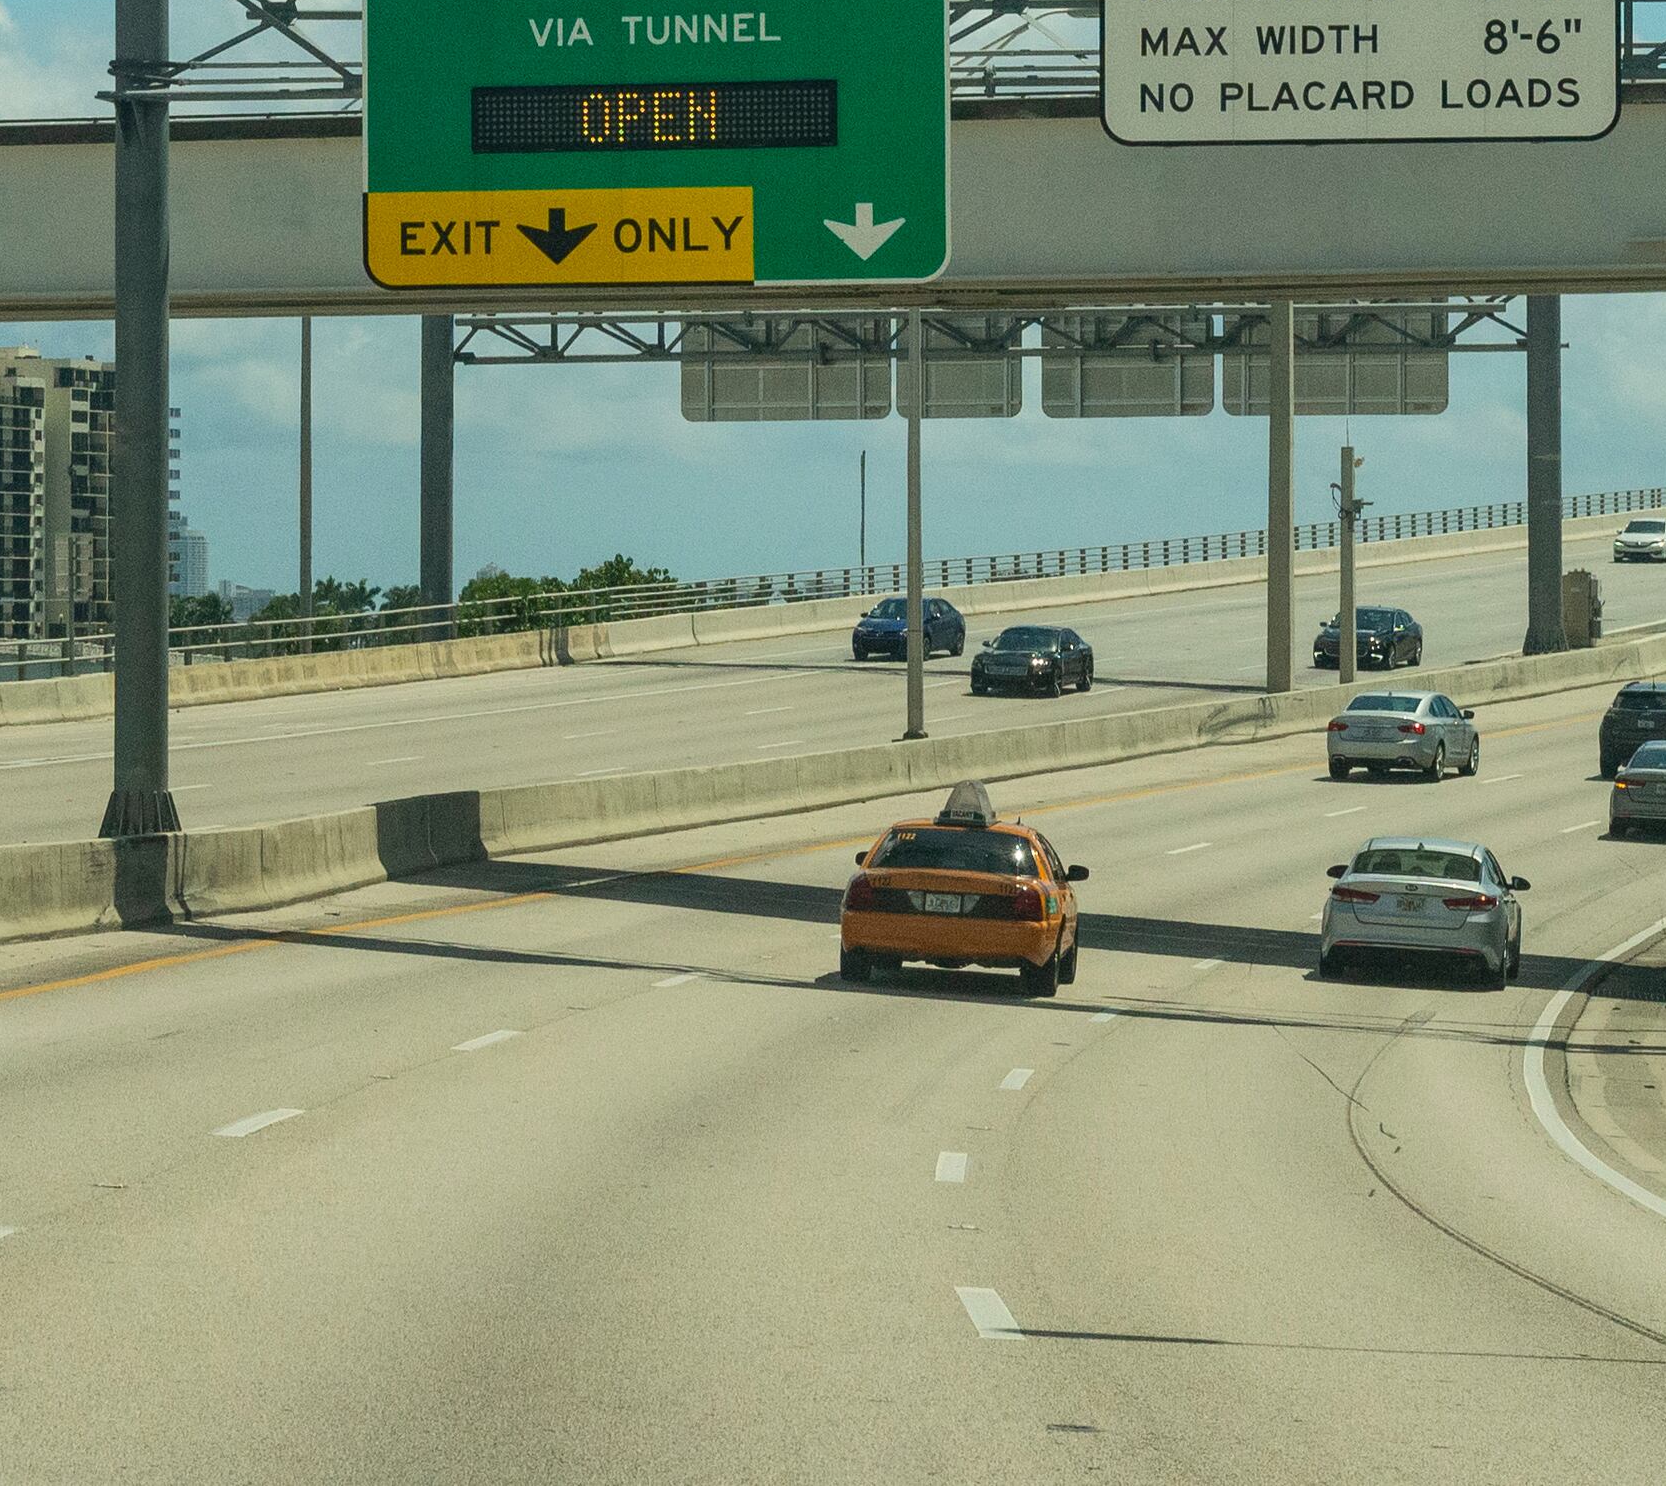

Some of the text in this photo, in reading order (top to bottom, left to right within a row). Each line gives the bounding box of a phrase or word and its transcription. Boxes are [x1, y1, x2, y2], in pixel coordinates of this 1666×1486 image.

[529, 12, 782, 47] VIA TUNNEL
[1139, 18, 1582, 57] MAX WIDTH 8'-6"
[1139, 77, 1581, 114] NO PLACARD LOADS
[581, 90, 717, 144] OPEN
[400, 215, 744, 256] EXIT ONLY
[897, 833, 917, 841] 1122
